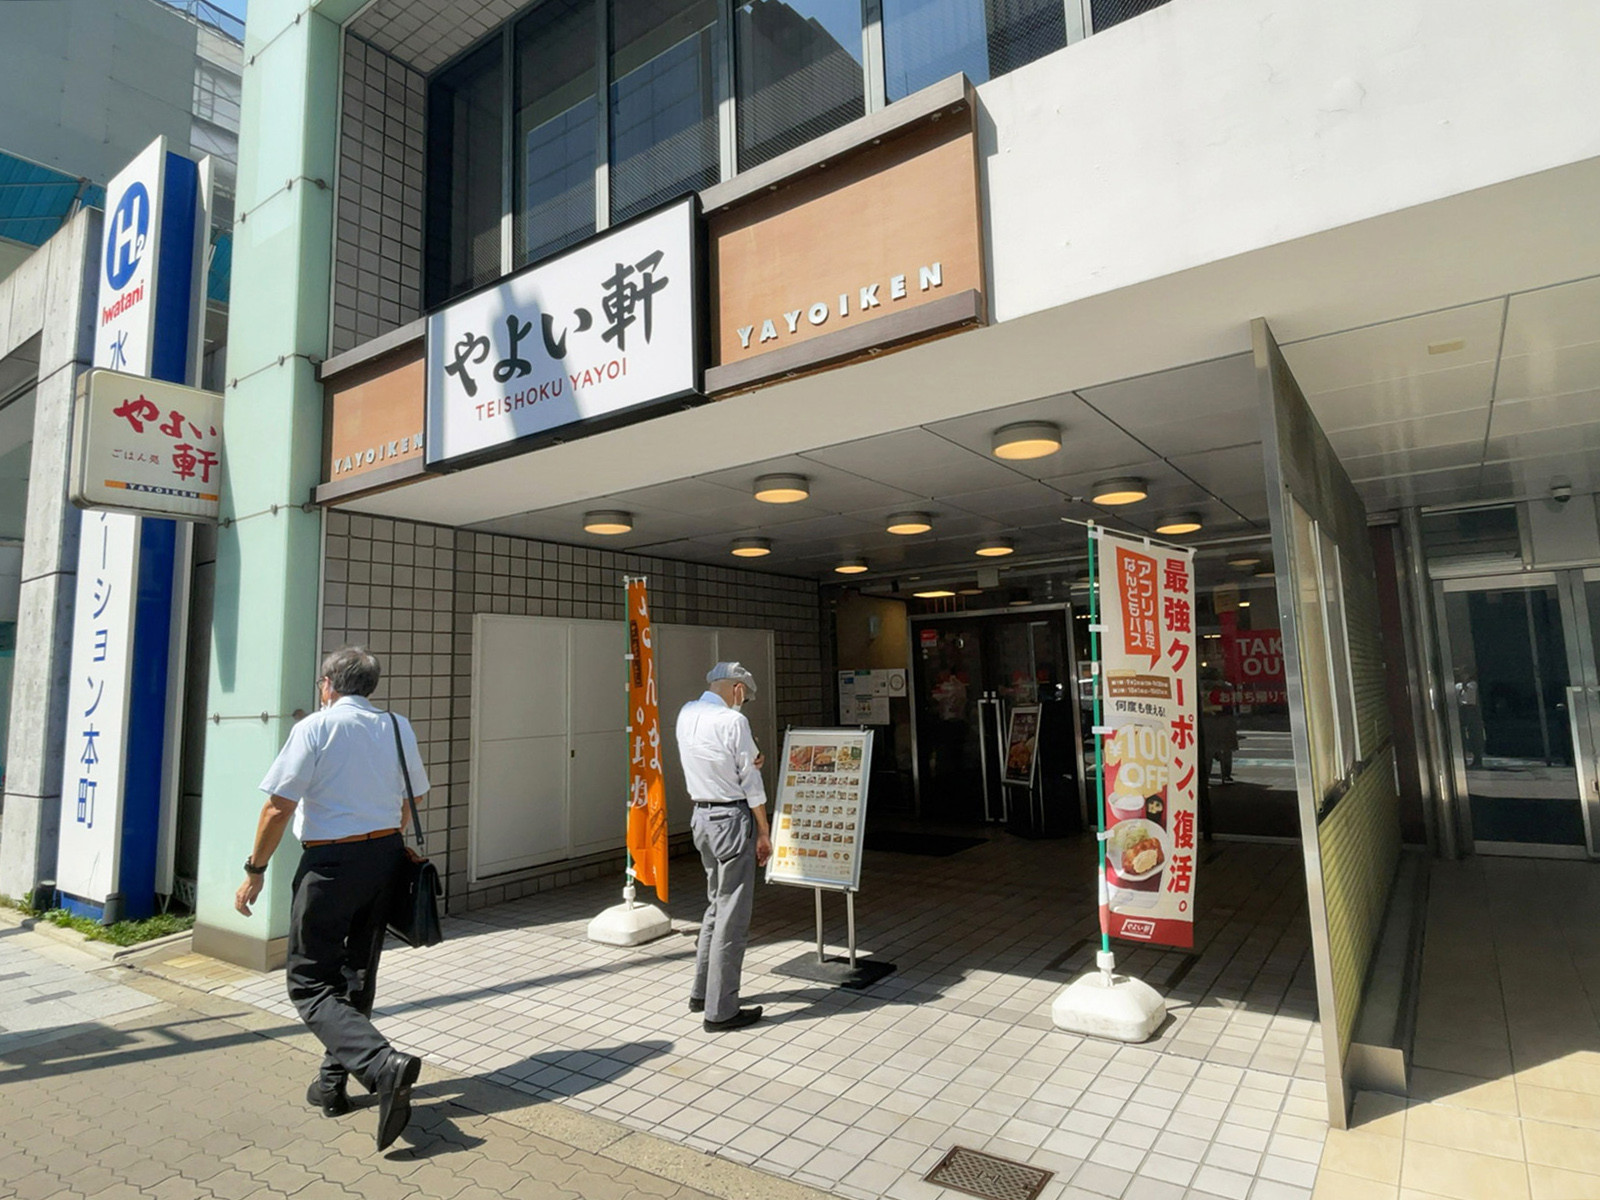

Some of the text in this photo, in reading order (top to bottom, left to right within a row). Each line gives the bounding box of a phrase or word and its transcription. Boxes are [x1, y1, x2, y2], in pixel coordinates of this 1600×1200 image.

[102, 279, 144, 327] Iwatani
[444, 249, 669, 398] やよい軒
[737, 262, 943, 348] YAYOIKEN
[475, 357, 627, 421] TEISHOKU YAYOI
[112, 449, 159, 465] ごはん処
[334, 432, 424, 475] YAYOIKEN
[129, 484, 198, 498] YAYOIKEN
[77, 511, 112, 829] ーション本町
[1243, 657, 1284, 676] OU
[1164, 558, 1195, 912] 最強クーポン、復活。
[1119, 762, 1169, 790] OFF
